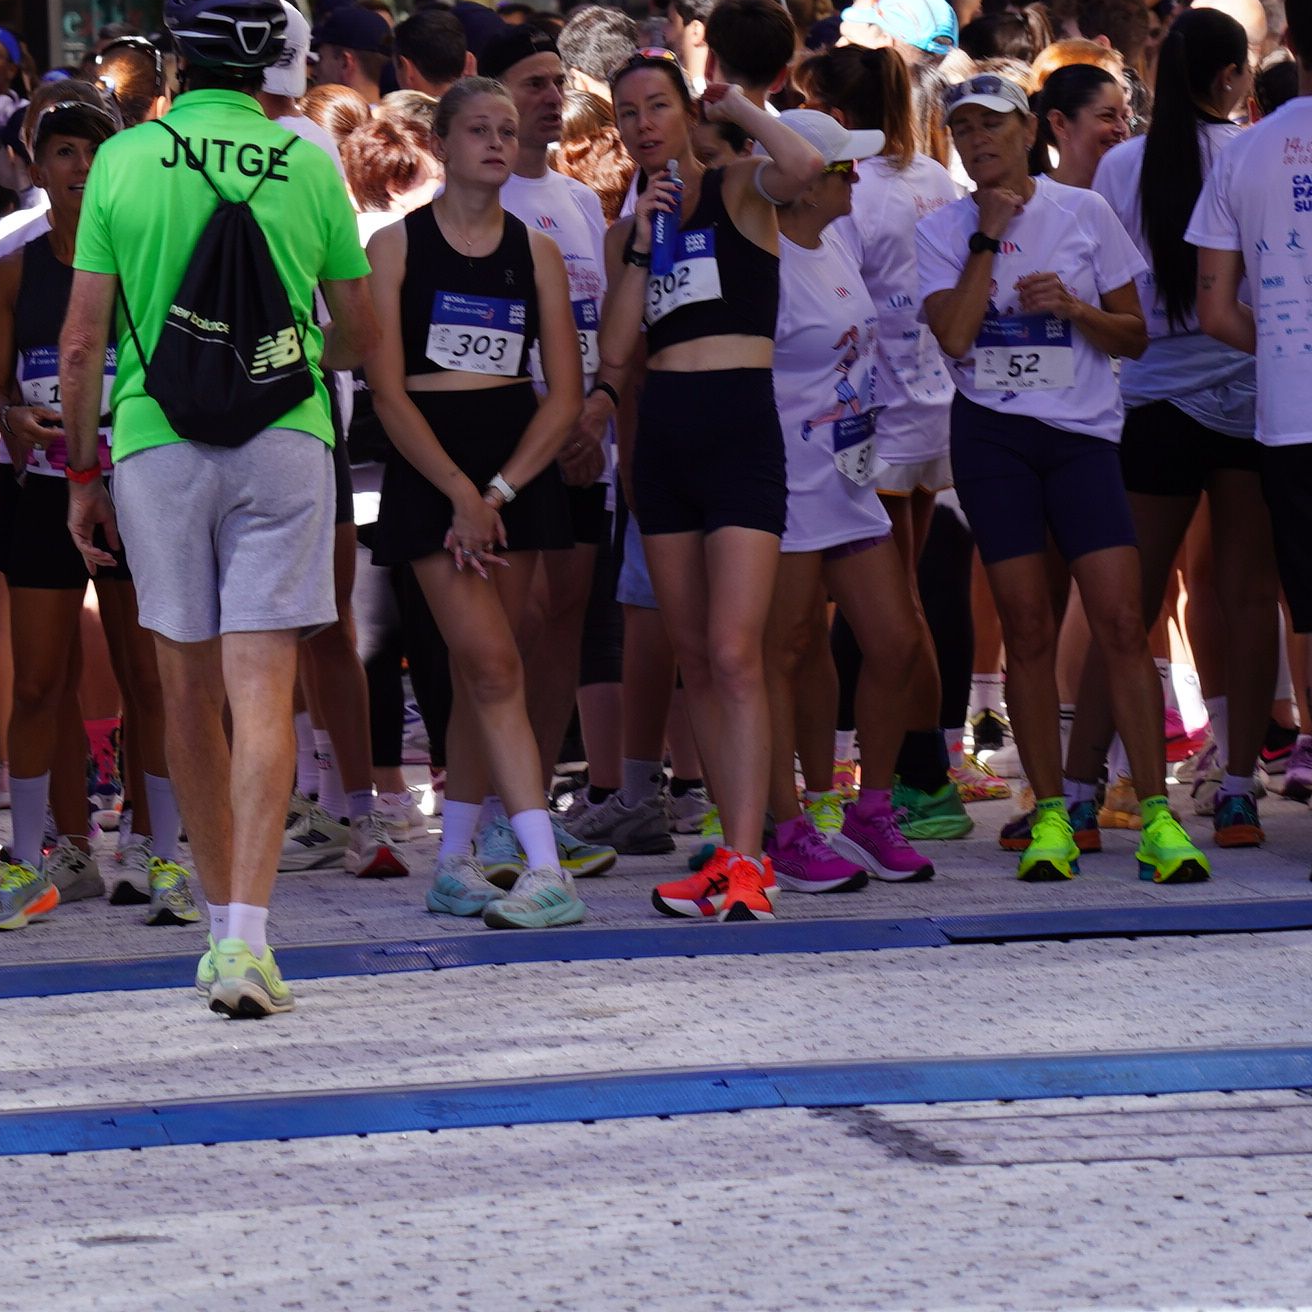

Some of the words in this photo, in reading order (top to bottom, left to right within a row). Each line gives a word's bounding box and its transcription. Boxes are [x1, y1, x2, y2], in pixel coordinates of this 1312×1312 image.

[161, 136, 289, 183] JUTGE
[649, 267, 691, 306] 302
[451, 333, 508, 362] 303
[1008, 353, 1041, 378] 52
